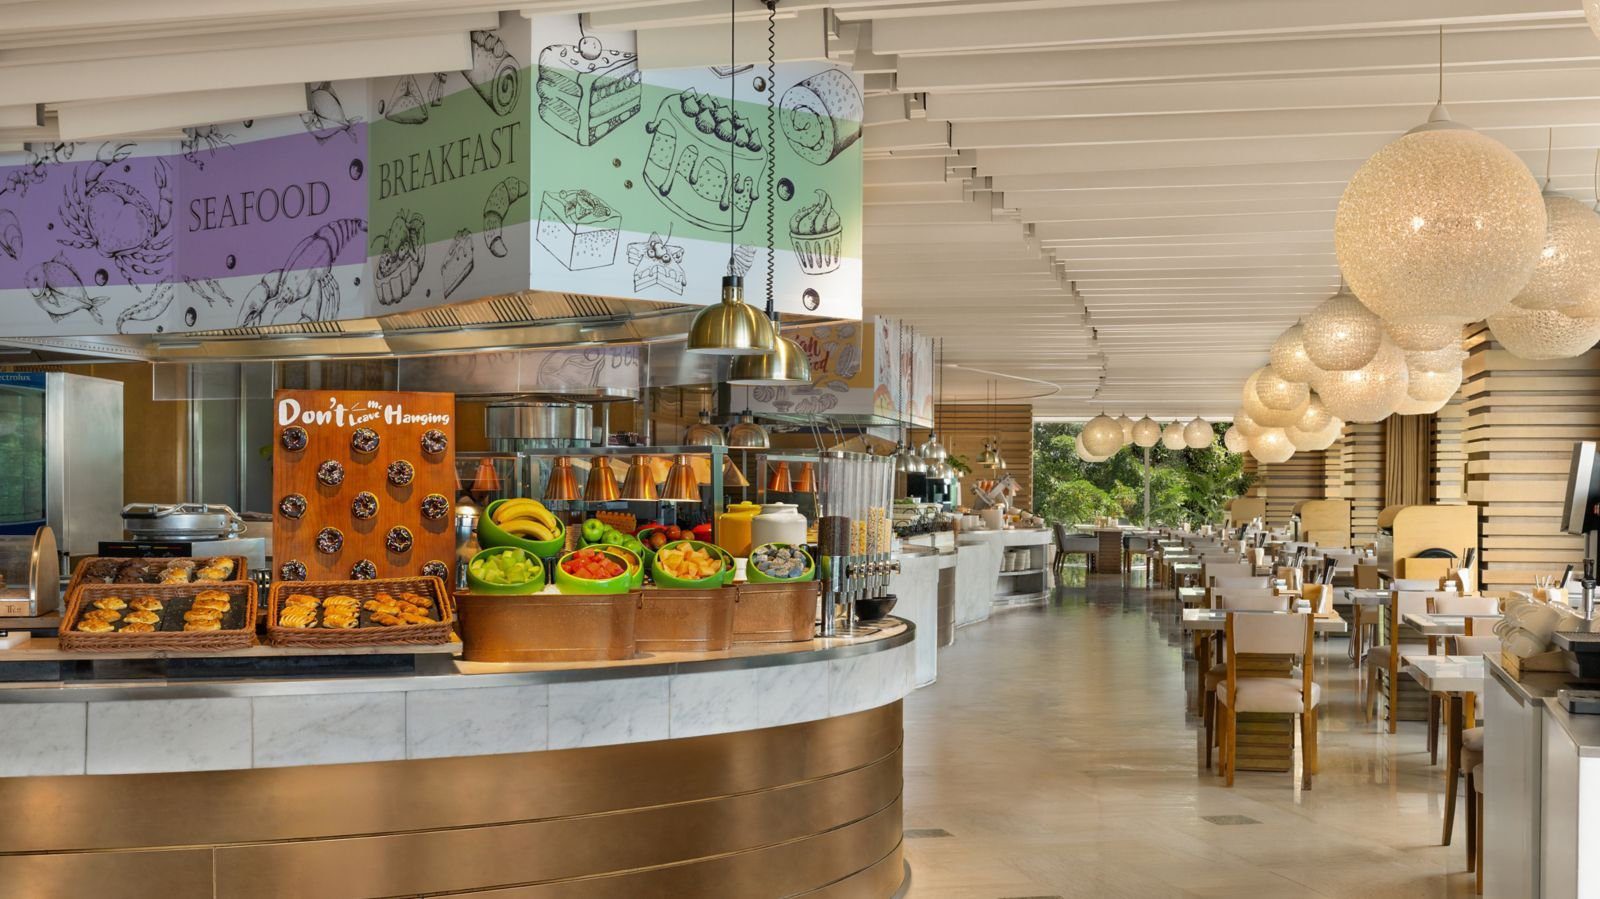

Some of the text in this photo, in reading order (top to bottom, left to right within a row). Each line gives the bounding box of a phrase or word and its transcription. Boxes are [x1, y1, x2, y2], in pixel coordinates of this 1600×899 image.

[378, 121, 521, 201] BREAKFAST
[188, 180, 330, 232] SEAFOOD
[278, 397, 349, 428] Don't
[349, 411, 380, 427] Leave
[384, 404, 450, 426] Hanging
